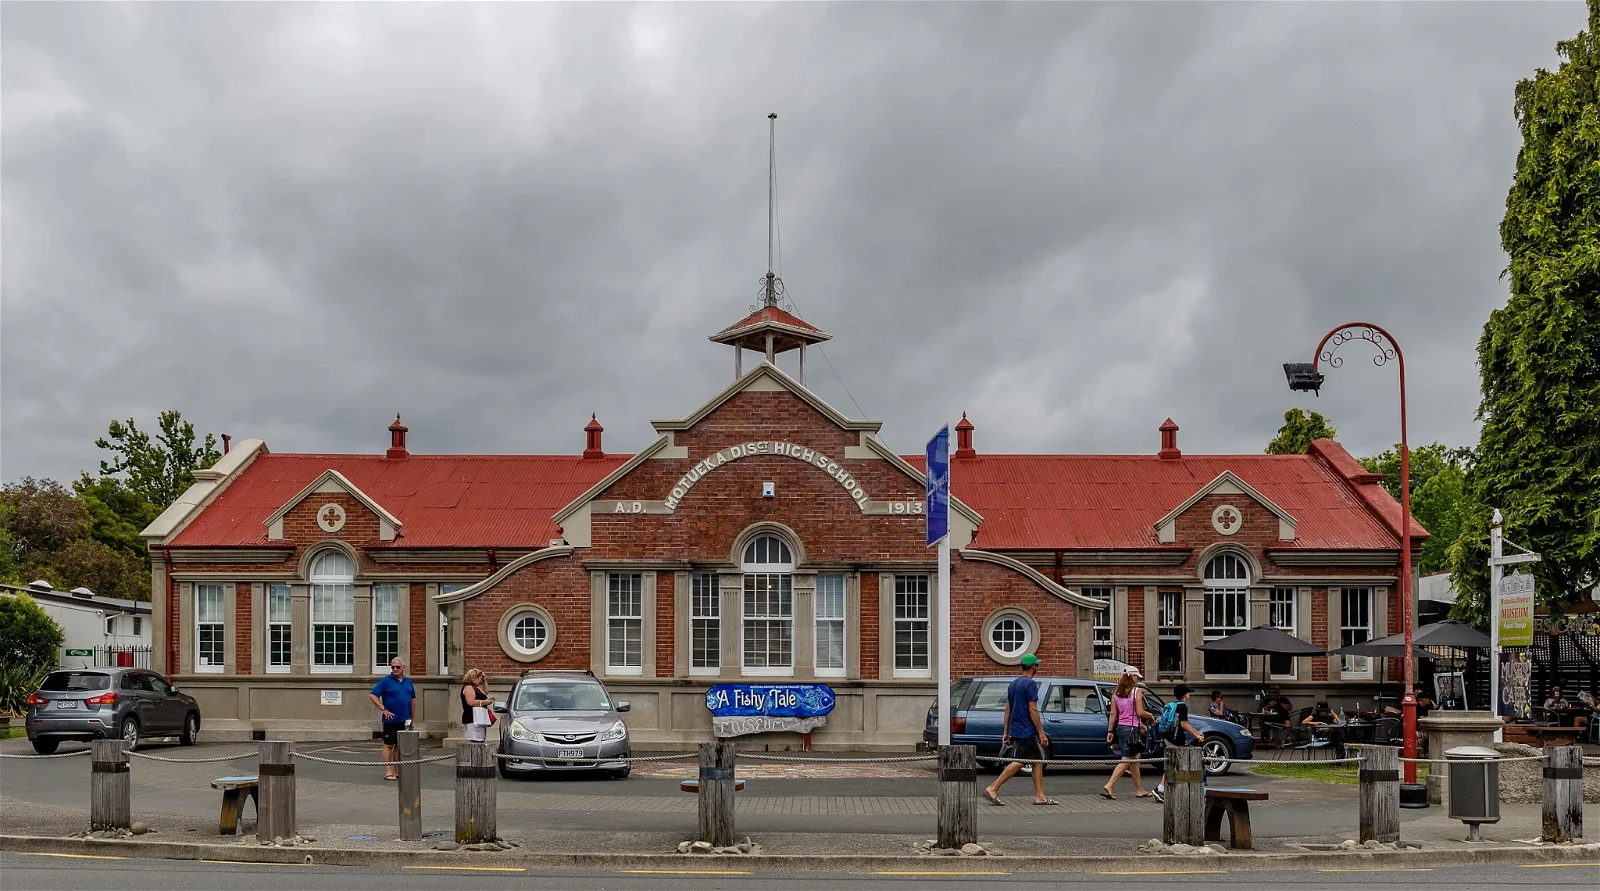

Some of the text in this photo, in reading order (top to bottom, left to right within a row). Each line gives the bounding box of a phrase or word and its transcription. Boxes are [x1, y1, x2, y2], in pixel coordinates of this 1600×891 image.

[664, 452, 728, 510] MOTUEKA
[775, 442, 815, 463] HIGH
[816, 456, 868, 511] SCHOOL
[614, 501, 647, 514] A.D.
[888, 502, 923, 514] 1913
[1502, 607, 1529, 619] MUSEUM
[716, 689, 797, 711] A Fishy Tale
[558, 749, 583, 758] FTH979
